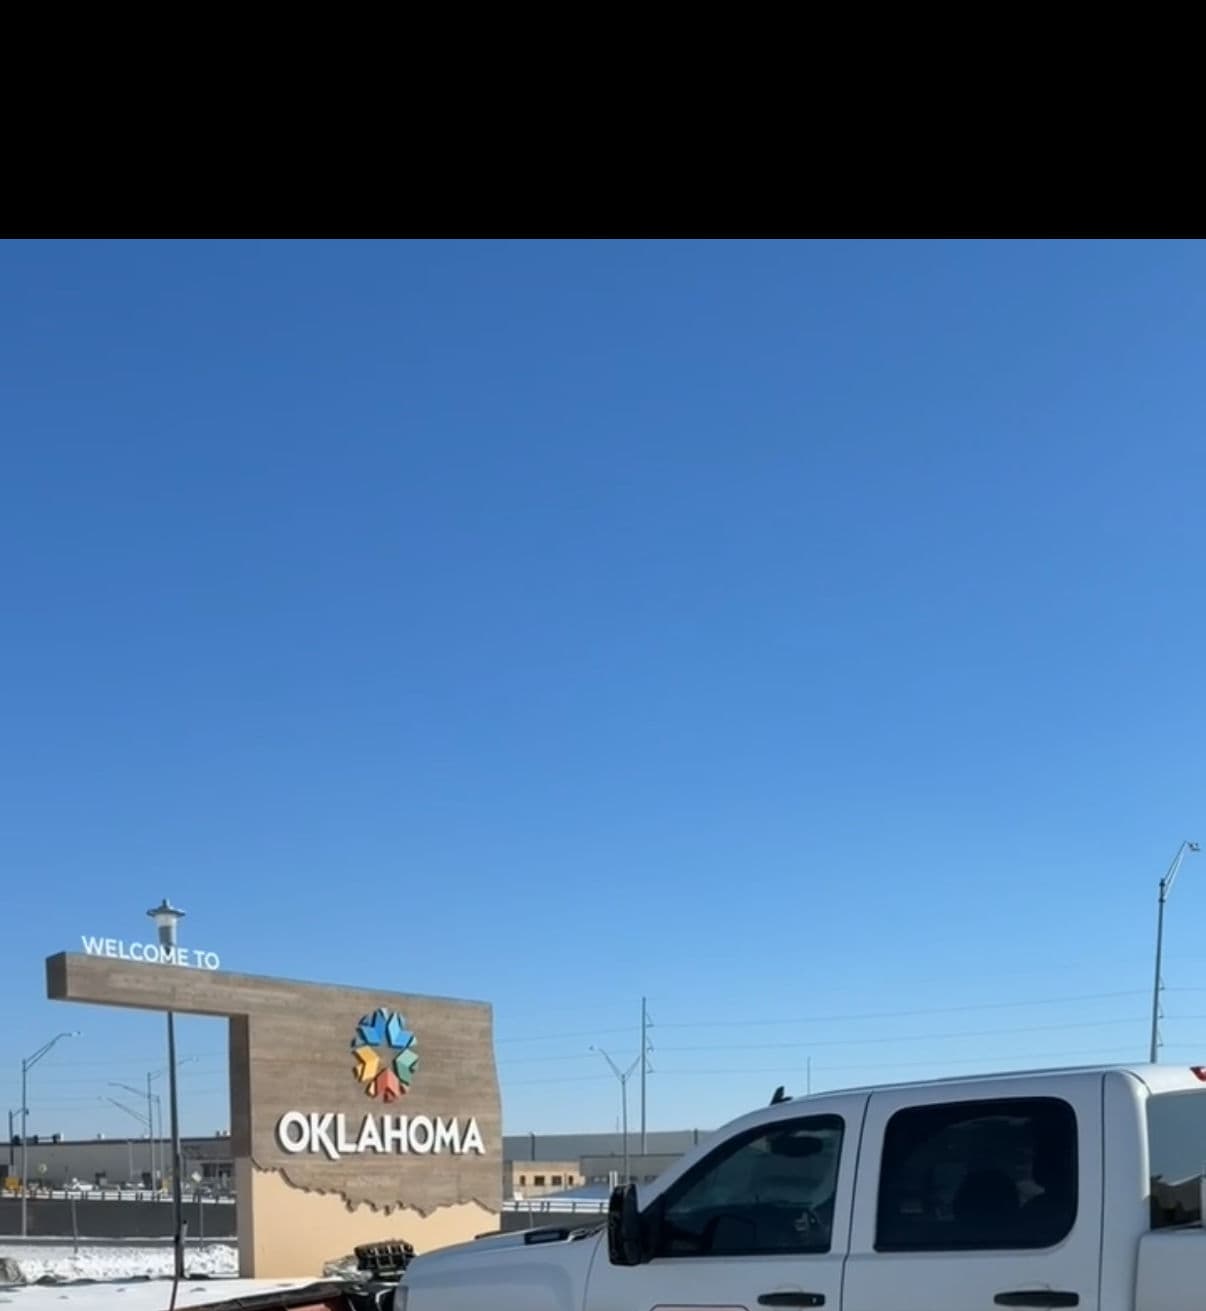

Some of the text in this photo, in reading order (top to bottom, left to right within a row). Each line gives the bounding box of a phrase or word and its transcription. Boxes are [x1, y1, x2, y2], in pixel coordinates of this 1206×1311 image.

[81, 935, 220, 970] WELCOME TO
[278, 1111, 486, 1160] OKLAHOMA
